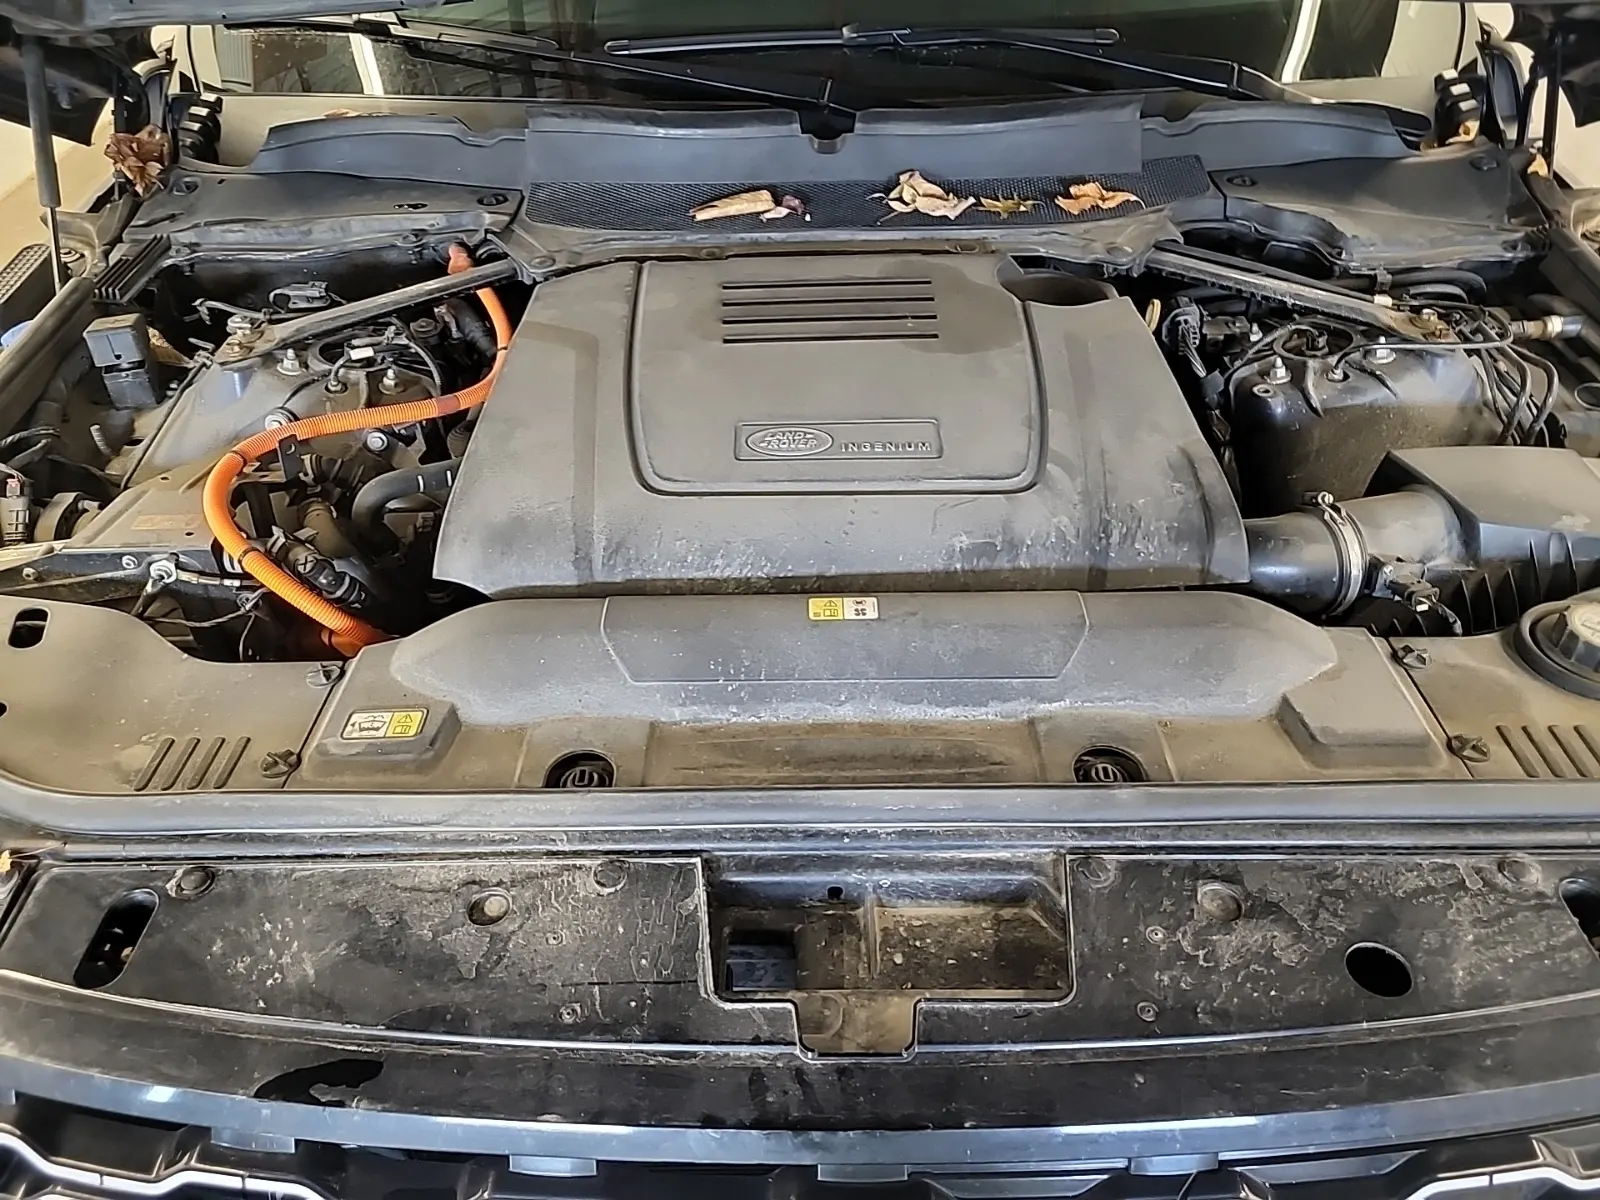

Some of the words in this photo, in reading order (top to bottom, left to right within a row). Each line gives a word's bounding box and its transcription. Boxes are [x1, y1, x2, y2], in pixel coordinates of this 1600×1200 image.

[764, 430, 806, 441] LAND
[767, 438, 818, 449] ROVER
[840, 441, 931, 452] INGENIUM
